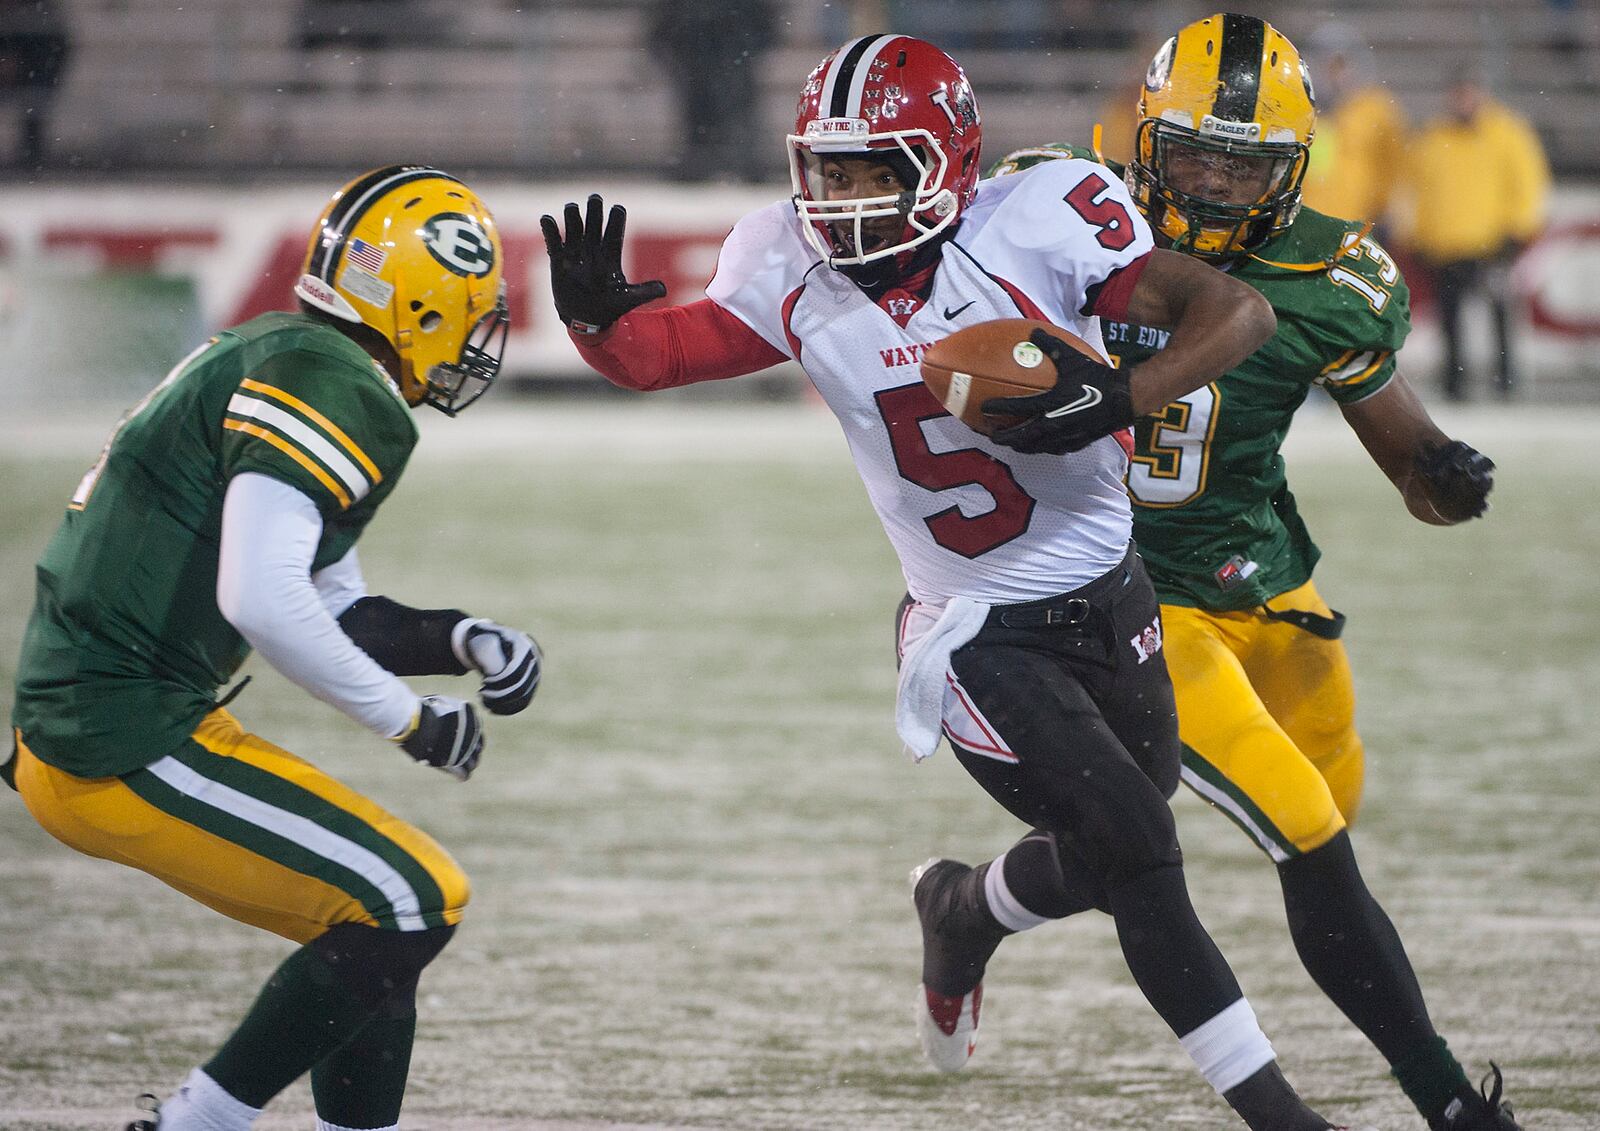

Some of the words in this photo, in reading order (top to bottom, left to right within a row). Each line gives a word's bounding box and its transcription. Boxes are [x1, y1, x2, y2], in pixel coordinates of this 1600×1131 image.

[1215, 123, 1246, 135] EAGLES
[424, 215, 494, 278] E
[1063, 172, 1136, 252] 5
[1327, 232, 1400, 316] 13
[873, 381, 1038, 560] 5
